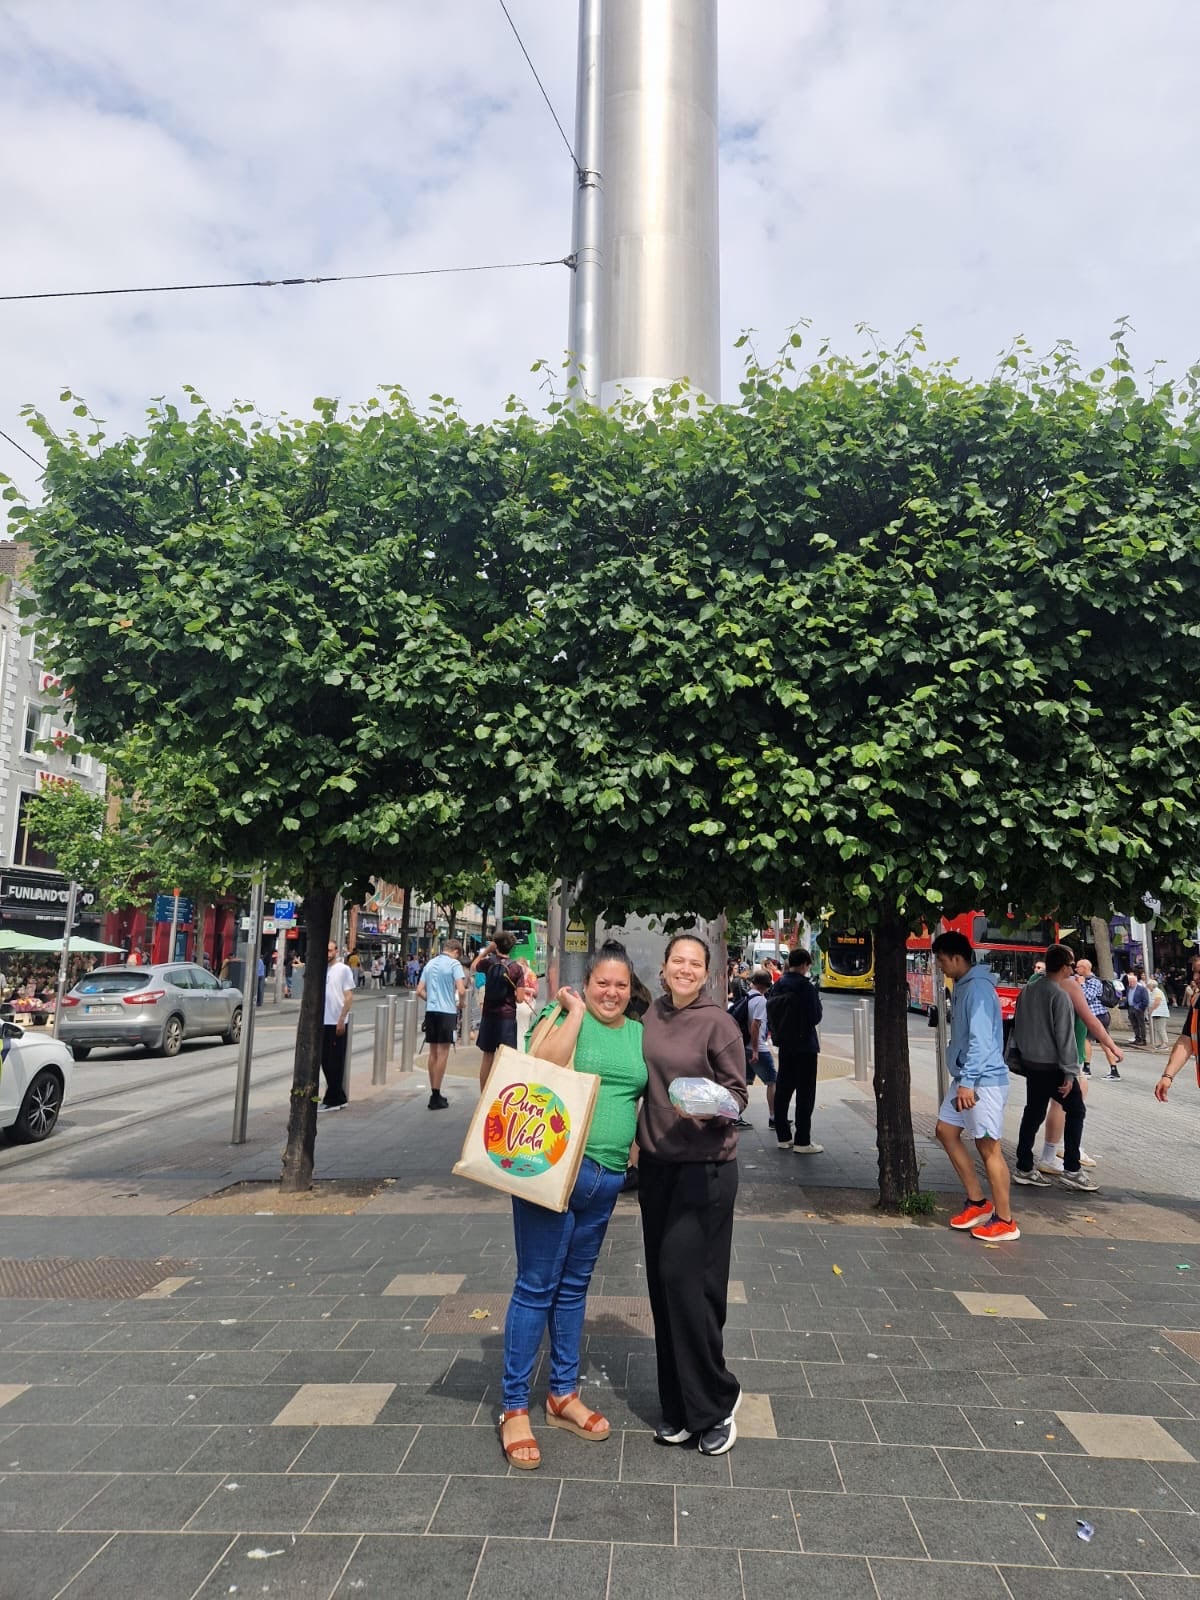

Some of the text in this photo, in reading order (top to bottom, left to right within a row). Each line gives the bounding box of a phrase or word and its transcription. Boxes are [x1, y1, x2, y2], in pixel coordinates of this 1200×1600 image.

[9, 886, 58, 902] FUNLAND
[499, 1083, 544, 1118] Pura
[507, 1112, 545, 1151] Vida
